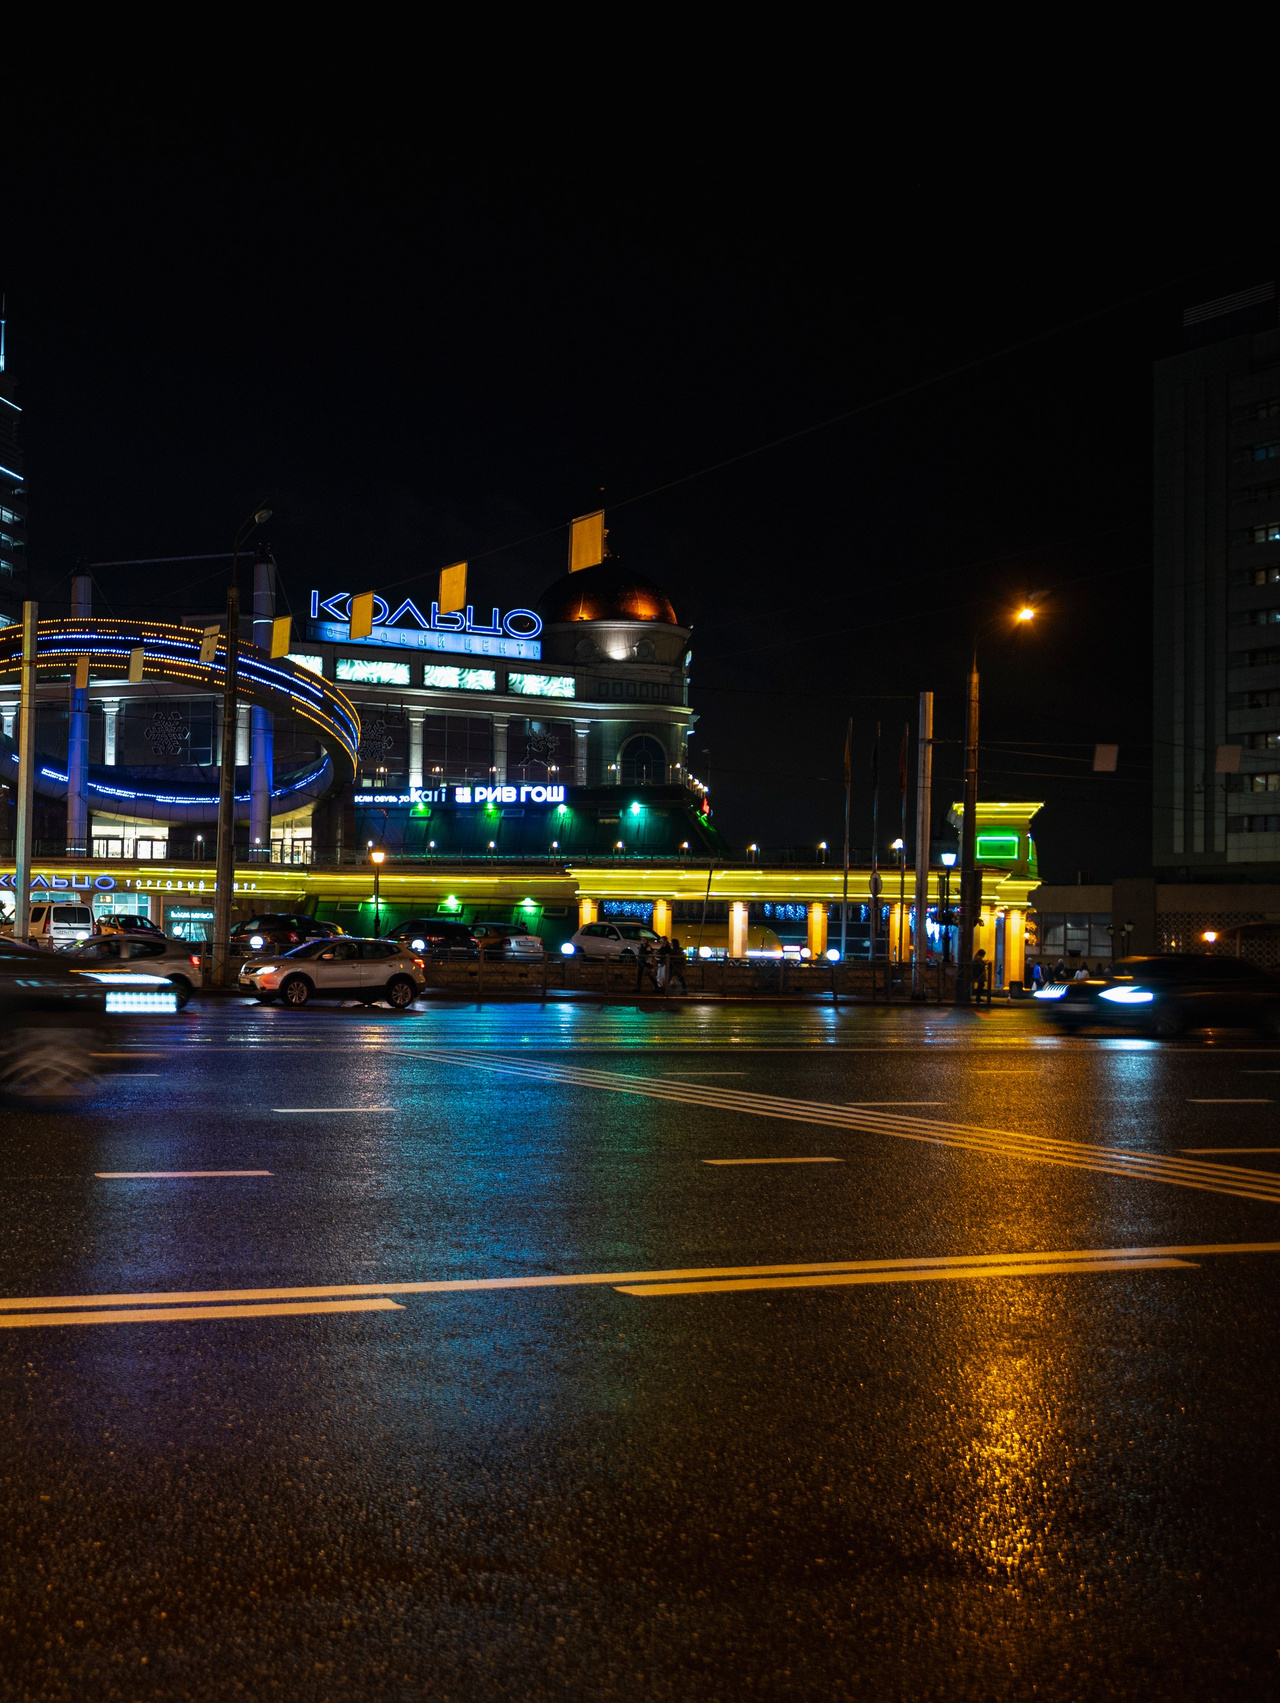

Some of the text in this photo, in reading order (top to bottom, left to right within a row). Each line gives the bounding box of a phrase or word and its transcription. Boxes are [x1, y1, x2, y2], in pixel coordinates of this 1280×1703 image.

[310, 589, 543, 640] КОЛЬЦО
[310, 625, 541, 657] ООВЫЙ ЦЕНТР
[354, 795, 373, 803] ЕСЛИ
[410, 787, 446, 802] kari
[475, 786, 565, 803] РИВ ГОШ
[125, 879, 257, 892] ТОРГОВЫЙ НТР
